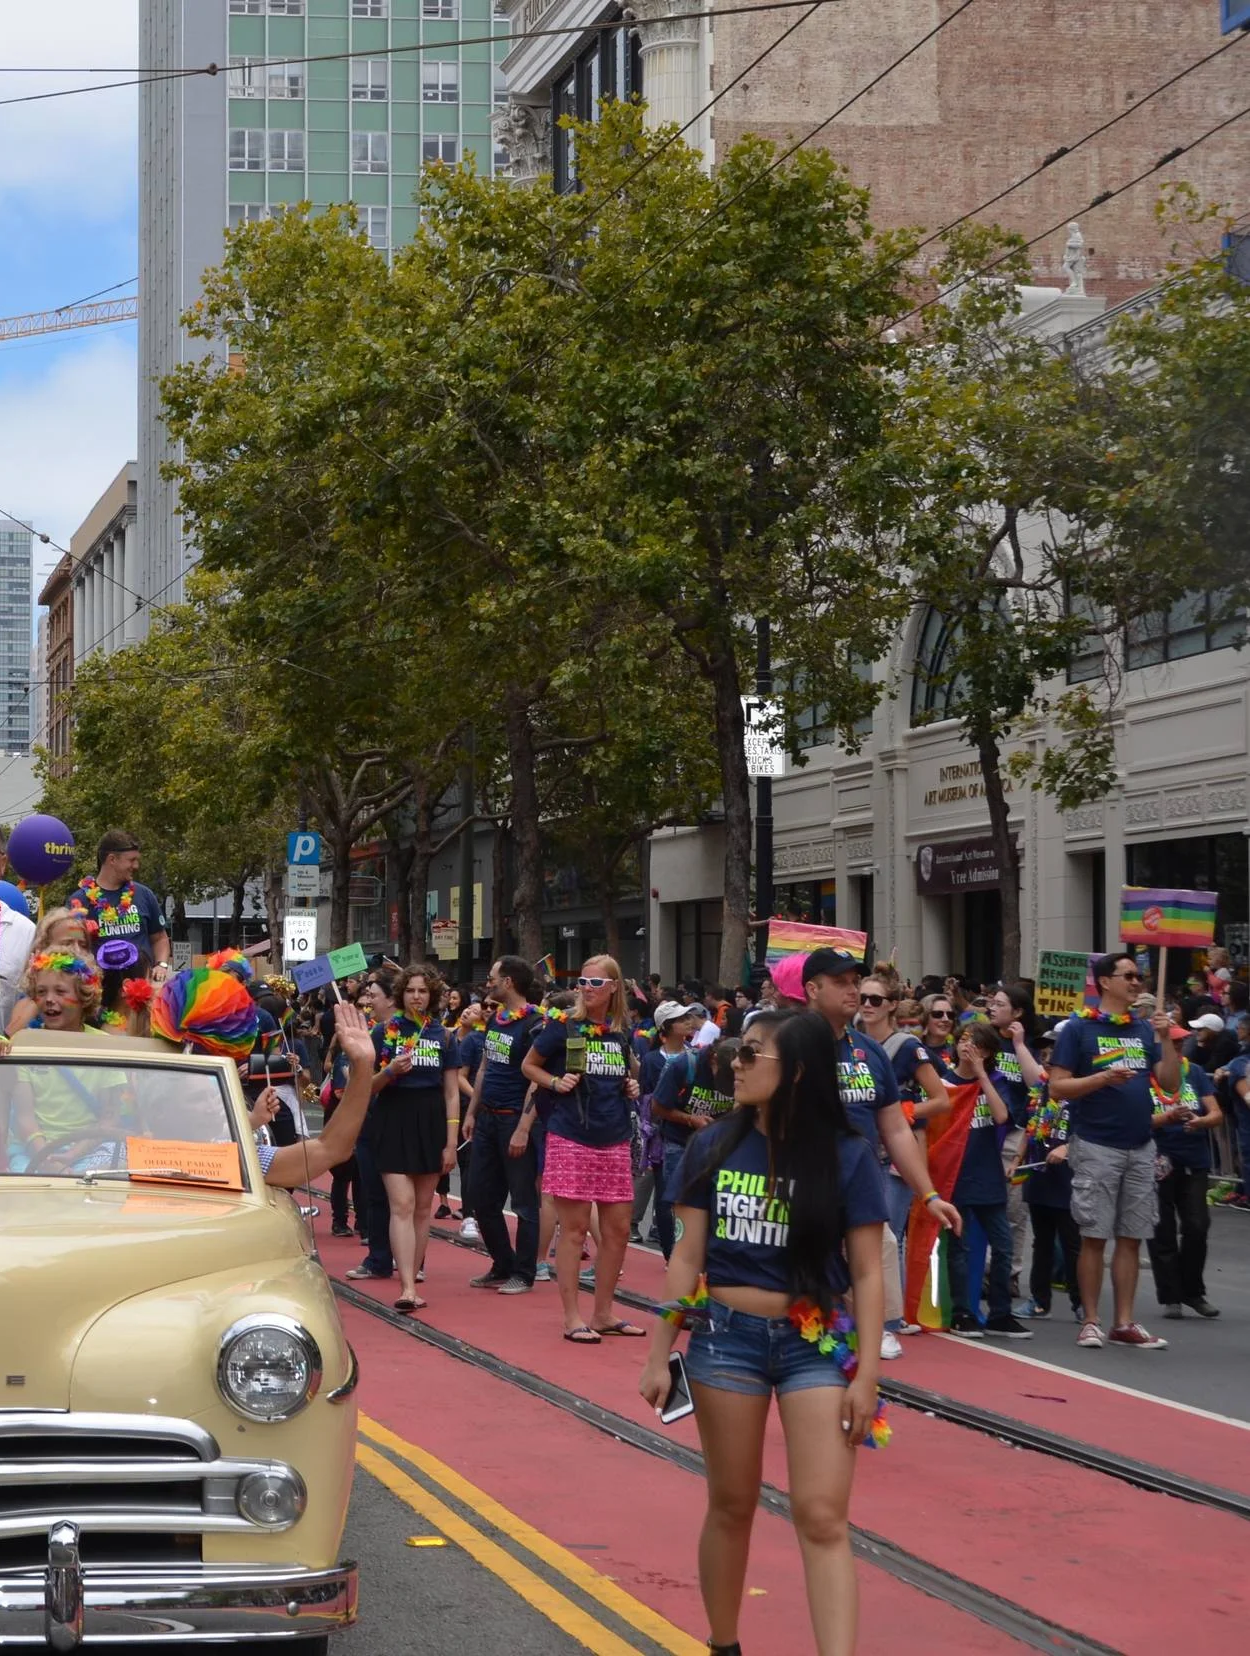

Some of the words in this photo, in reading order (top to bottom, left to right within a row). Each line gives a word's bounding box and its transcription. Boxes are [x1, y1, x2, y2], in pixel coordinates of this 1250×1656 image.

[751, 765, 775, 773] BIKES
[98, 923, 141, 937] &UNITING
[291, 938, 308, 952] 10
[1039, 981, 1077, 997] PHIL
[1038, 998, 1075, 1012] TING
